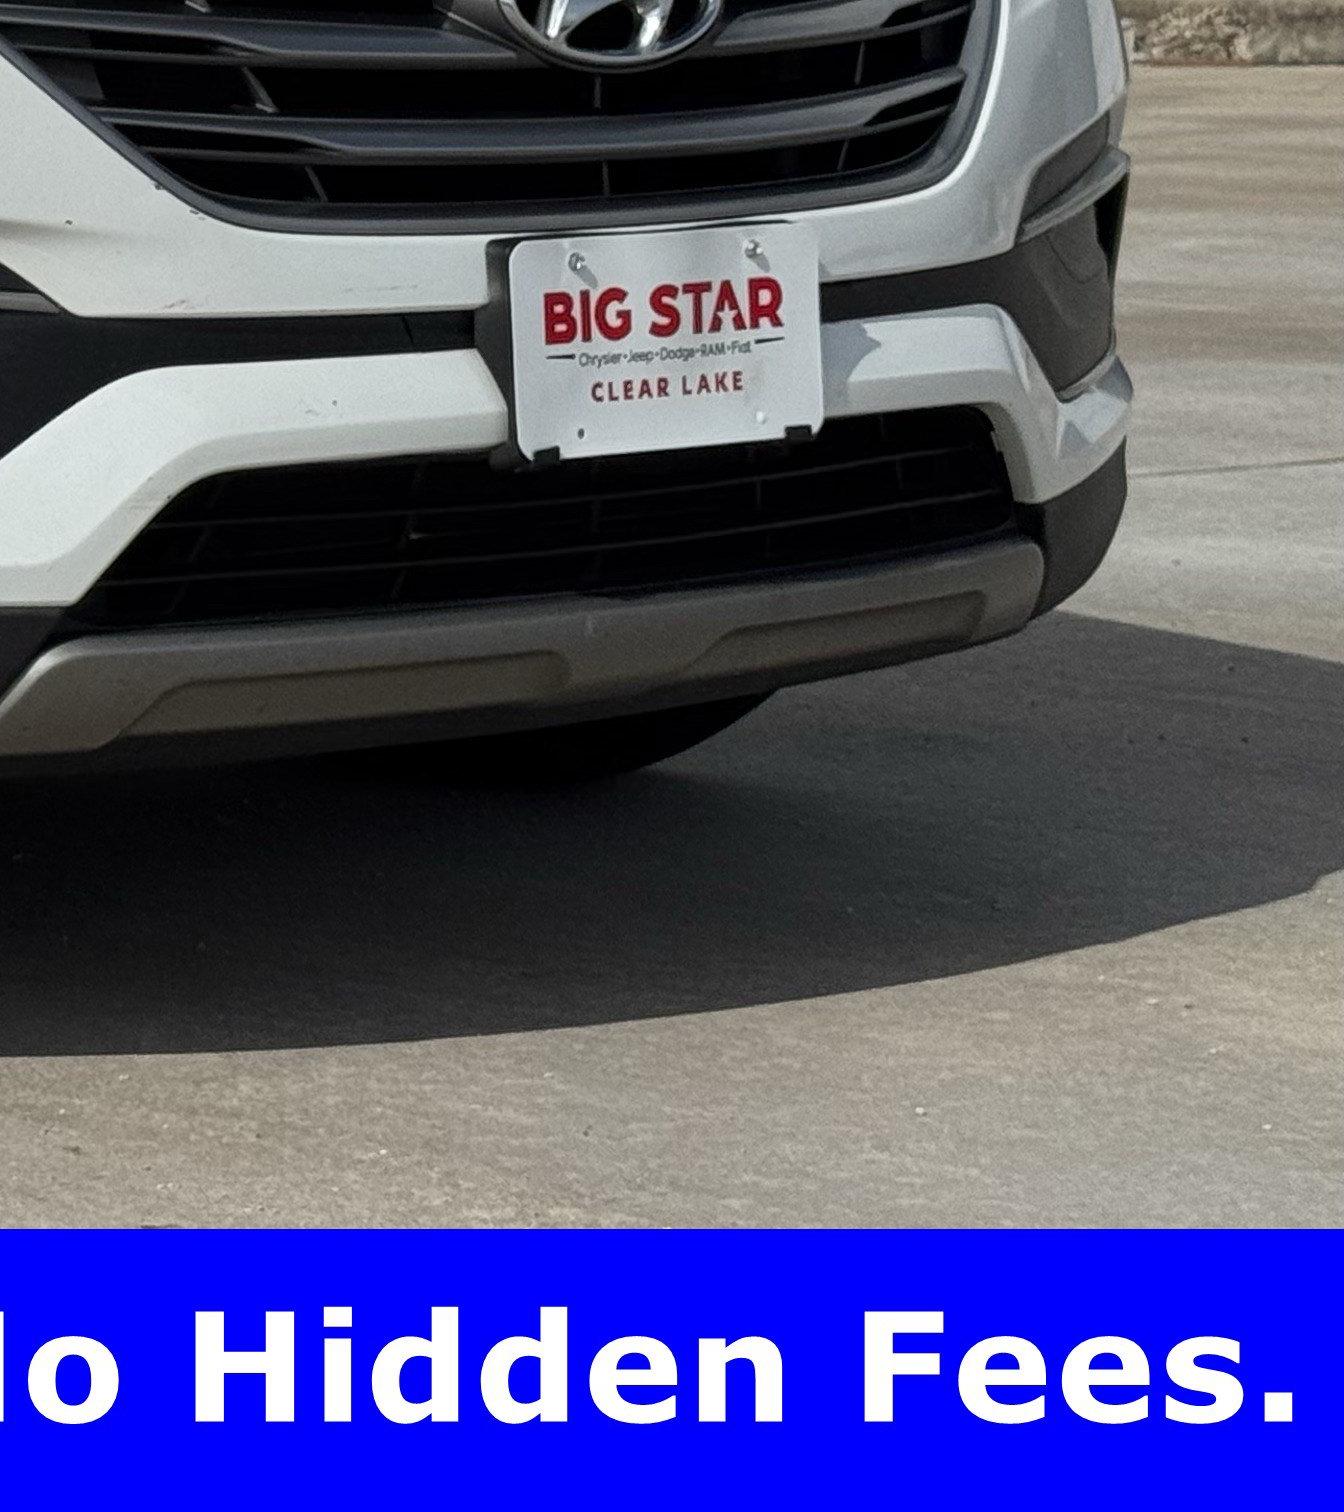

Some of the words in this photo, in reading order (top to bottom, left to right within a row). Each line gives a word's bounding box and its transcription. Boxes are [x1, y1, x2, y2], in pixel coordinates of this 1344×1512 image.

[543, 287, 632, 346] BIG
[649, 276, 784, 338] STAR
[661, 345, 696, 362] Dodge
[700, 341, 726, 357] RAM
[591, 376, 670, 404] CLEAR
[682, 370, 744, 396] LAKE
